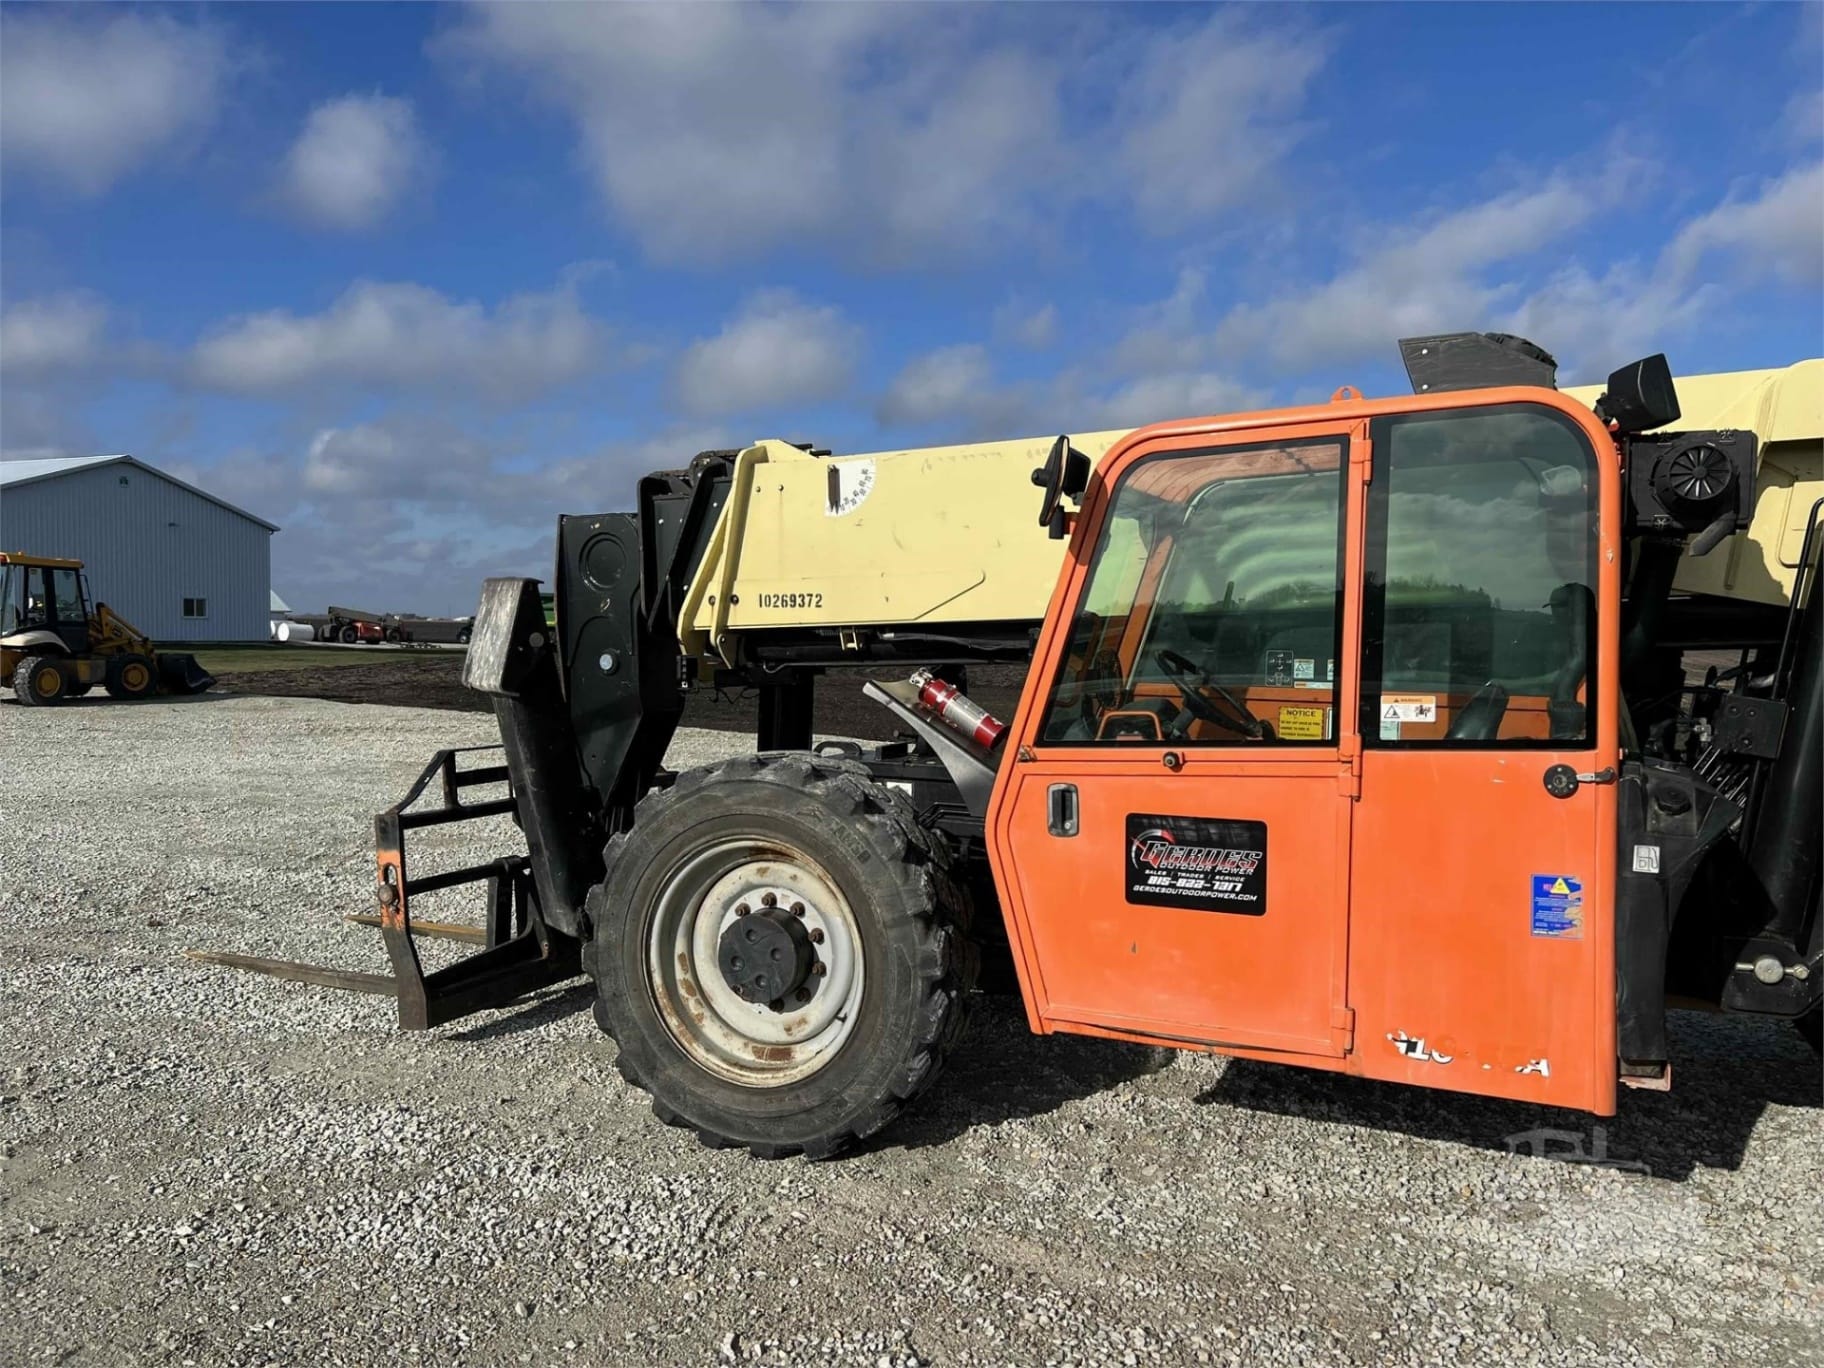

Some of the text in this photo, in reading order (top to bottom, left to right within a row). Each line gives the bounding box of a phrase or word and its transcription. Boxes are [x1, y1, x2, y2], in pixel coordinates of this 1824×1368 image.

[759, 593, 823, 609] 10269372
[1286, 709, 1317, 718] NOTICE
[1140, 840, 1263, 870] GERDES
[1160, 862, 1254, 876] OUTDOOR POWER
